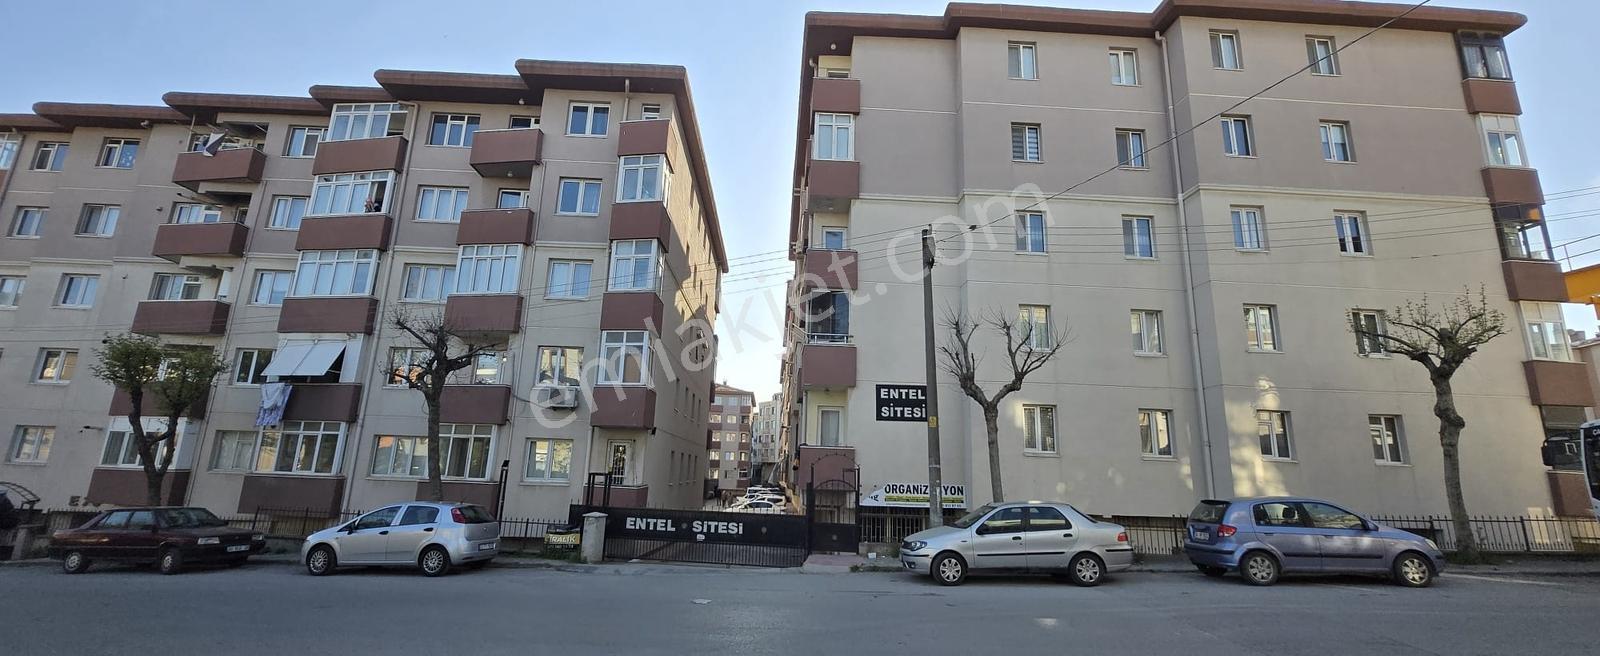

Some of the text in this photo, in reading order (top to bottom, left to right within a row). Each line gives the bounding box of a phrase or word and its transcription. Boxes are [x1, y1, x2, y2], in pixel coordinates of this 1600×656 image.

[880, 388, 926, 400] ENTEL
[880, 402, 927, 418] SİTESİ
[884, 483, 964, 496] ORGANİZYON
[625, 517, 676, 532] ENTEL
